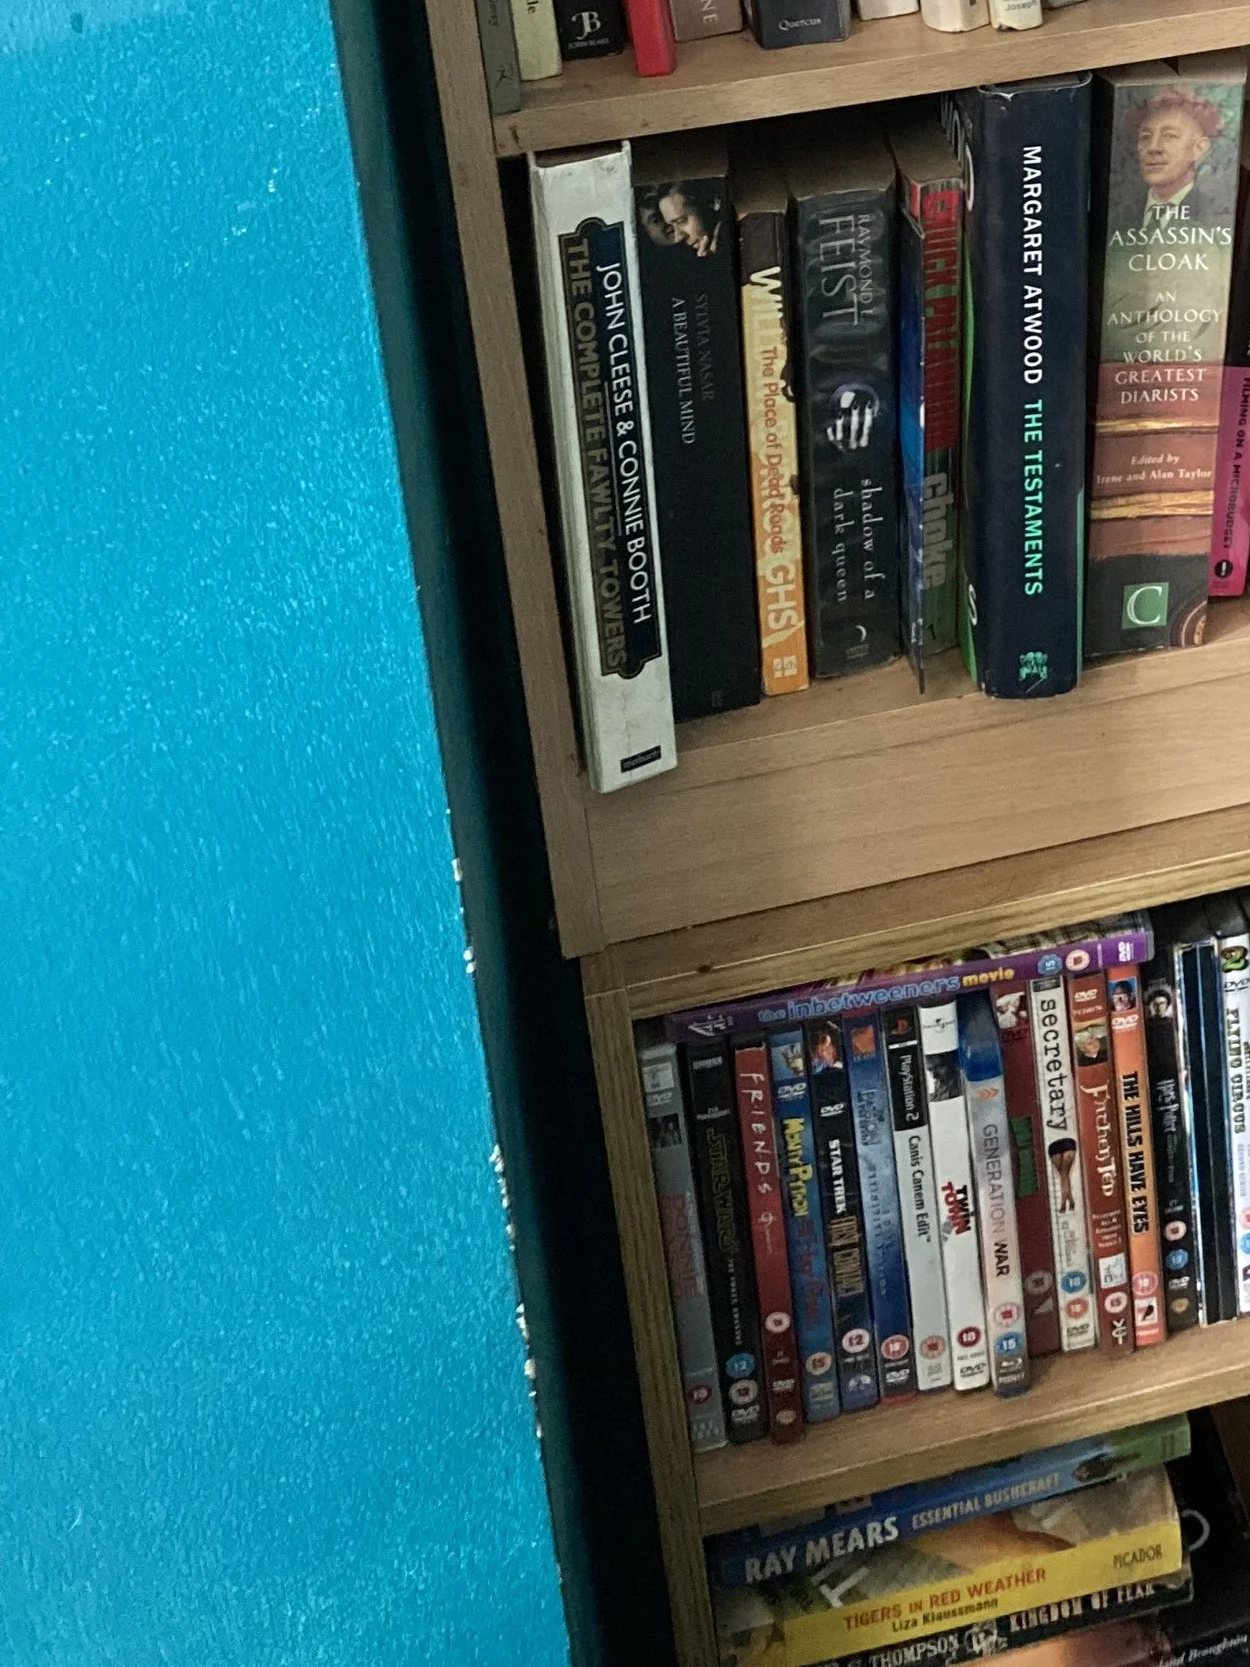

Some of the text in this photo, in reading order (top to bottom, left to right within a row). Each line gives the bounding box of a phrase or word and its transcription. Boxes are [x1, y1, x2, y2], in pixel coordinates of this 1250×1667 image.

[1152, 204, 1191, 222] THE
[818, 214, 859, 326] FEIST
[1127, 252, 1210, 273] CLOAK
[1106, 308, 1225, 327] ANTHOLOGY
[1154, 290, 1178, 303] AN
[761, 346, 779, 378] The
[1135, 330, 1192, 344] OF THE
[1022, 144, 1044, 596] MARGARET ATWOOD THE TESTAMENTS
[1114, 367, 1208, 386] GREATEST
[762, 380, 779, 430] Place
[1119, 387, 1201, 405] DIARISTS
[596, 262, 653, 625] JOHN CLEESE CONNIE BOOTH
[831, 542, 848, 603] queen
[1039, 998, 1069, 1133] secretary
[828, 1138, 843, 1181] STAR
[908, 1134, 926, 1209] Canis Canem
[1121, 1069, 1150, 1235] THE HILLS HAVE EYES
[981, 1123, 1011, 1279] GENERATION WAR
[744, 1496, 982, 1586] RAY MEARS ESSENTIAL
[1112, 1543, 1164, 1569] PICADOR
[842, 1567, 1048, 1633] TIGERS IN RED WEATHER
